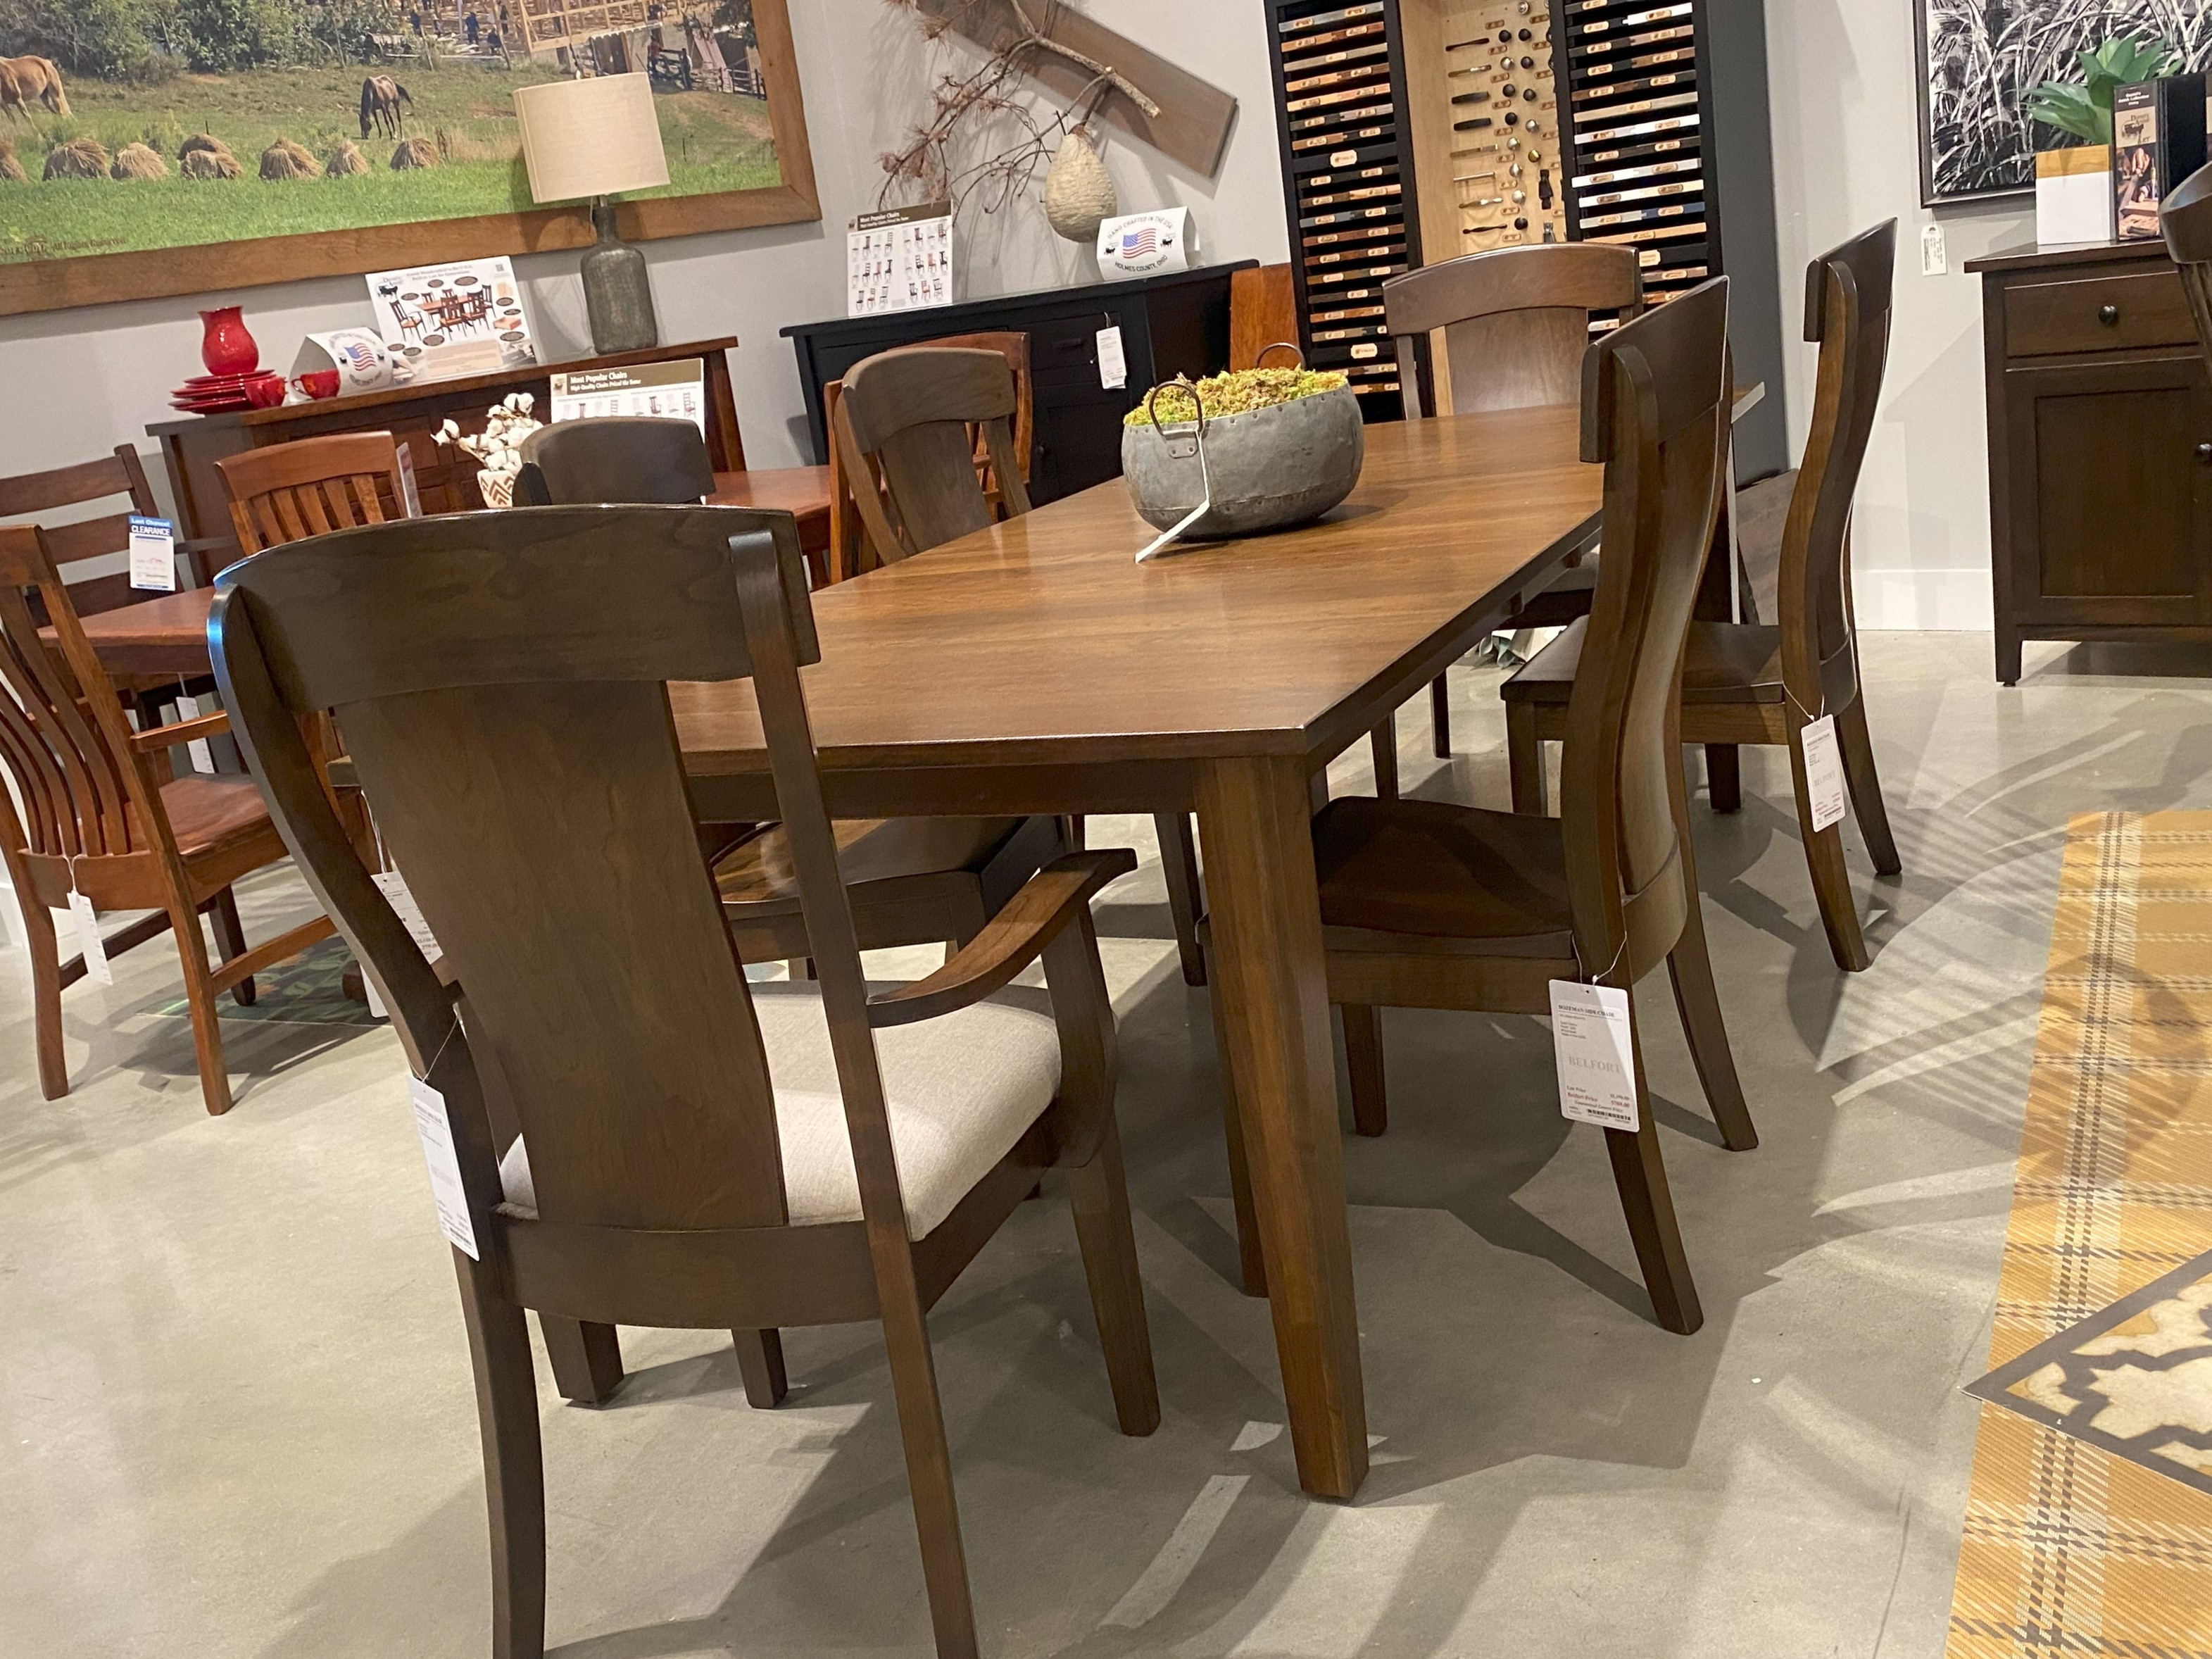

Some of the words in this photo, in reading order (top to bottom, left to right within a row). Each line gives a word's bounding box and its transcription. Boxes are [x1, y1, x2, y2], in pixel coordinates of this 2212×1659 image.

[1107, 225, 1122, 239] HAND
[1123, 216, 1148, 228] CRAFTED
[1163, 219, 1173, 229] USA
[1114, 261, 1136, 272] HOLMES
[1157, 255, 1168, 266] OHIO
[570, 376, 584, 384] Most
[585, 373, 608, 383] Popular
[608, 371, 627, 380] Chairs
[131, 525, 170, 536] CLEARANCE
[1568, 1056, 1623, 1074] BELFORT
